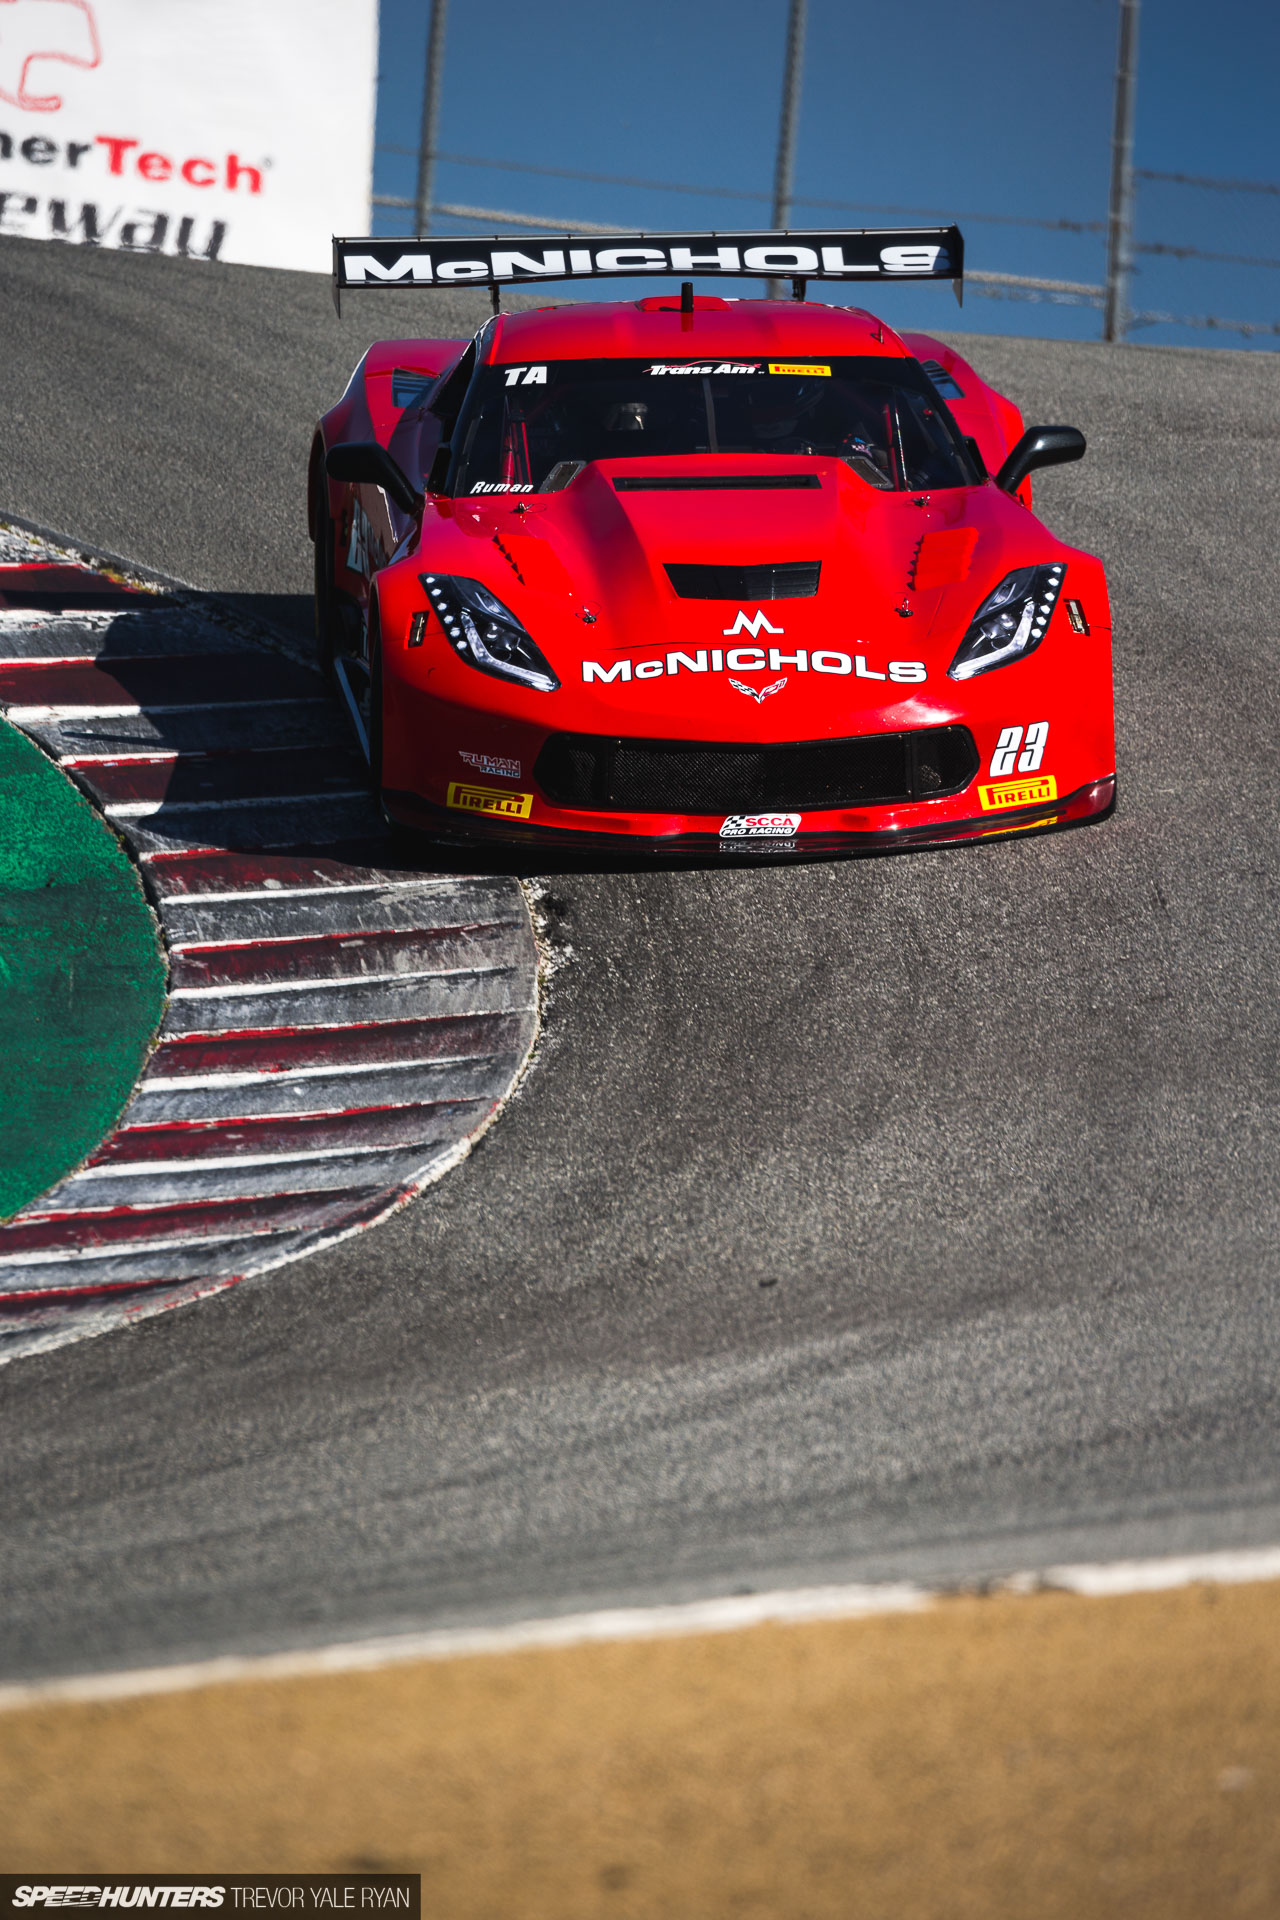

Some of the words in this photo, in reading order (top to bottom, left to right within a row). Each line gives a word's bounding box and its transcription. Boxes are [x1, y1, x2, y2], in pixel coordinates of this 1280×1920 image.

[343, 245, 950, 282] McNICHOLS
[504, 366, 547, 387] TA
[470, 481, 534, 494] Ruman
[581, 648, 929, 684] McNICHOLS
[989, 720, 1049, 777] 23
[458, 751, 520, 770] RUMAN
[480, 766, 520, 778] RACING
[452, 785, 525, 814] PIRELLI
[985, 779, 1050, 806] PIRELLI
[722, 828, 747, 836] PRO
[748, 827, 793, 835] RACING
[745, 817, 794, 827] SCCA
